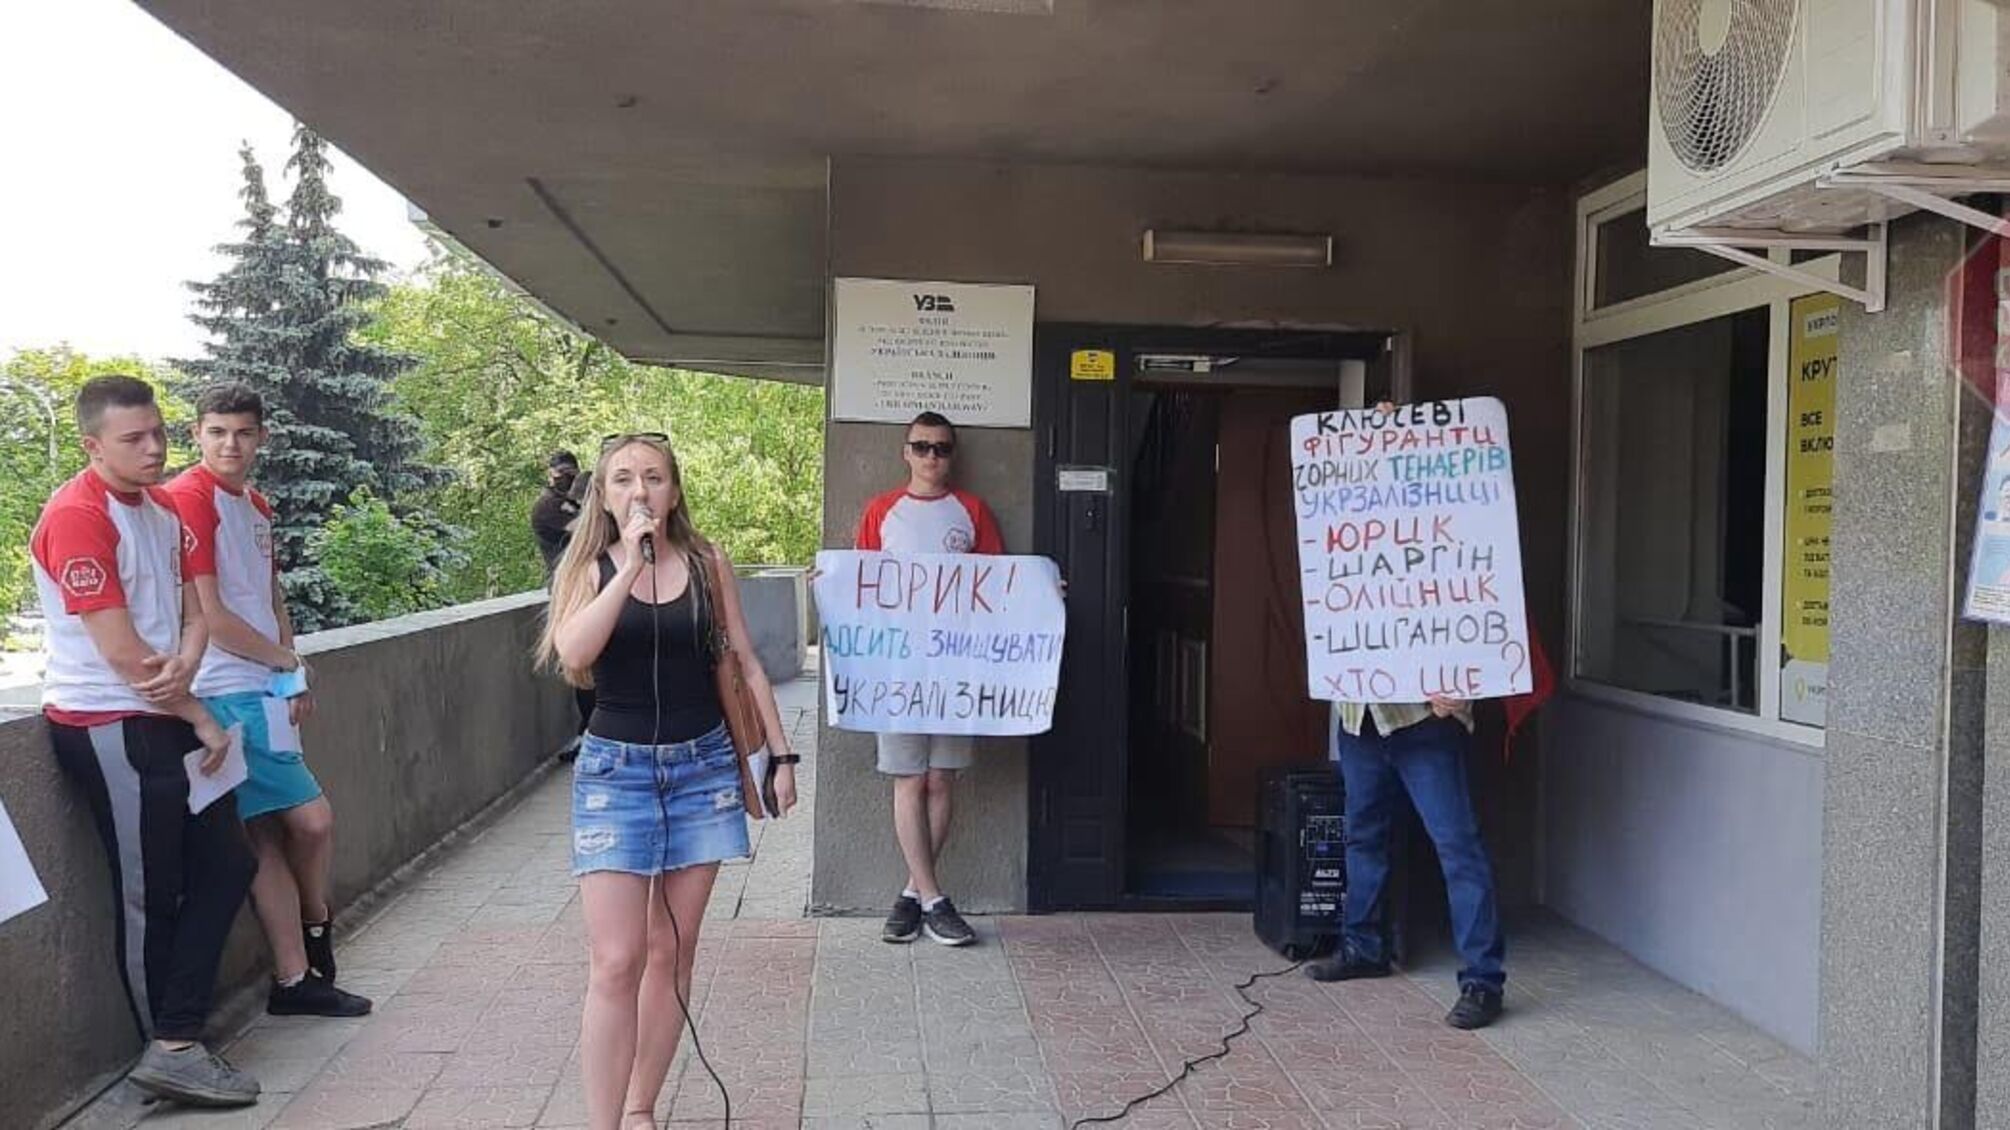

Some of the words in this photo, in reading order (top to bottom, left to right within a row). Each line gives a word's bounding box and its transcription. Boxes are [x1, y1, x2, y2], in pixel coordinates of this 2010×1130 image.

[1800, 411, 1822, 427] ВСЕ
[856, 558, 1016, 615] ЮРИК!
[1324, 668, 1396, 699] ХТО
